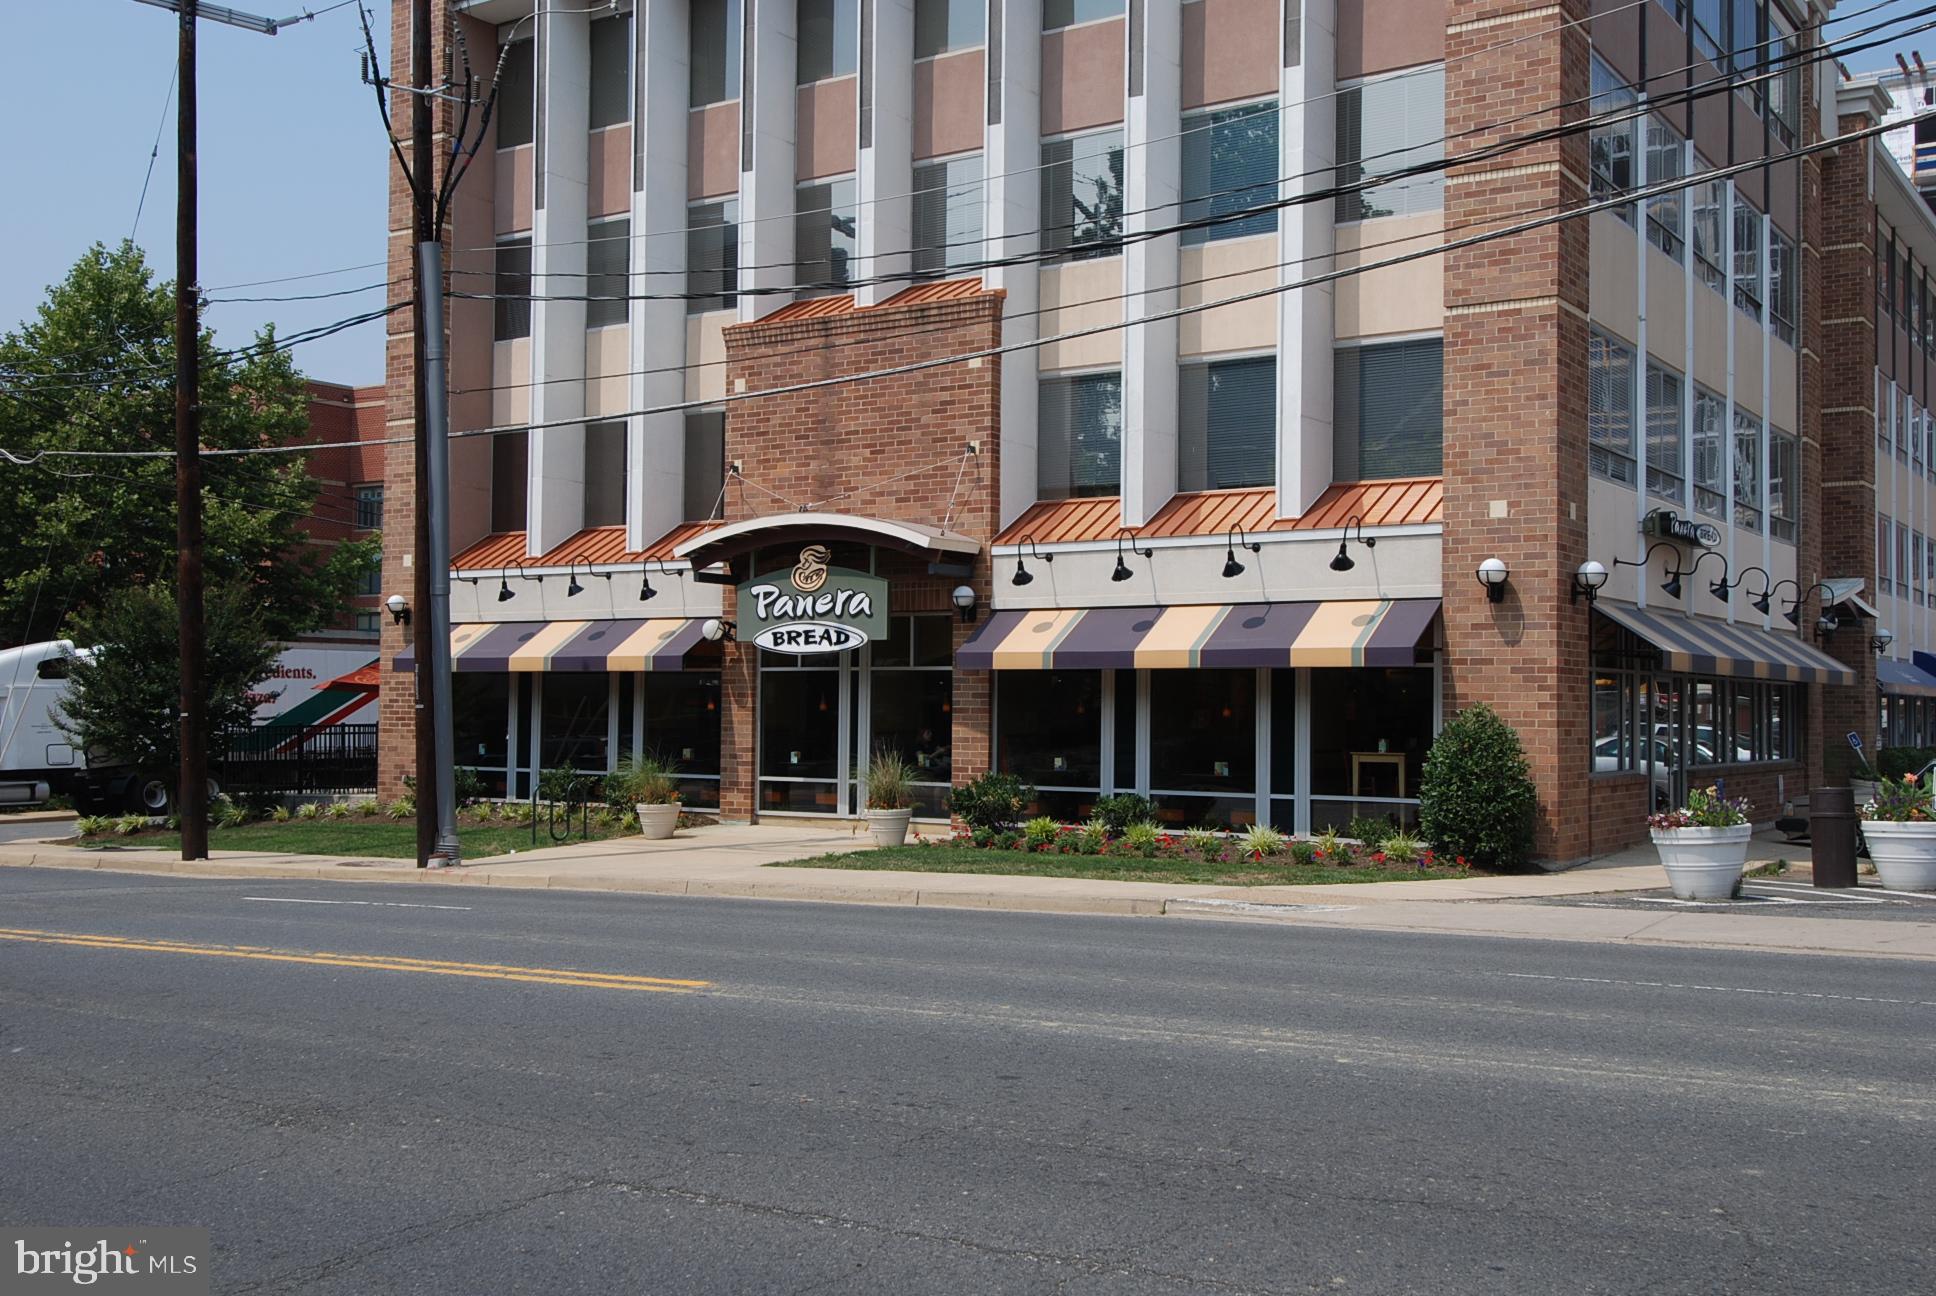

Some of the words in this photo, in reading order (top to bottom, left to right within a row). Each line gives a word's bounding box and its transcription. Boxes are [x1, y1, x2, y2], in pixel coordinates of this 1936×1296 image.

[750, 584, 872, 619] Panera
[771, 629, 851, 647] BREAD
[264, 664, 317, 679] edients.
